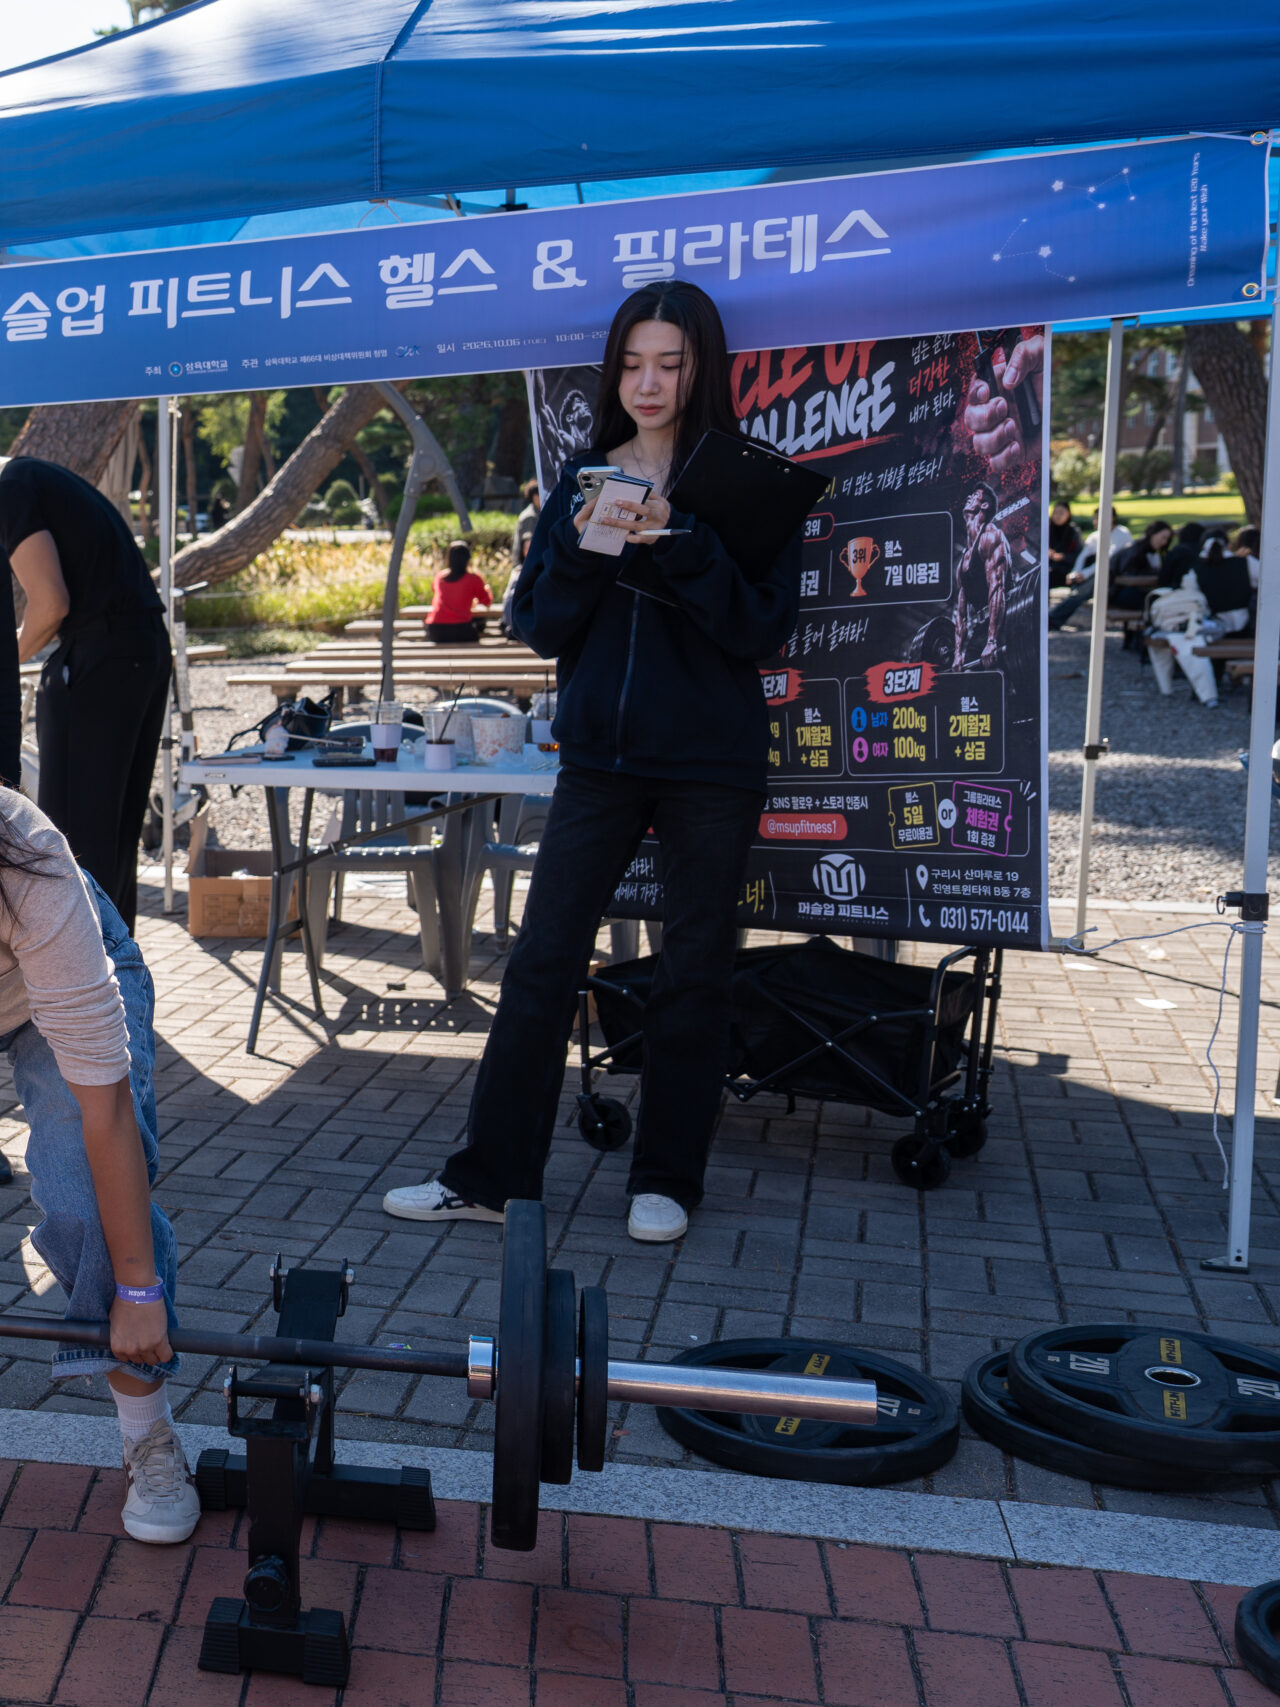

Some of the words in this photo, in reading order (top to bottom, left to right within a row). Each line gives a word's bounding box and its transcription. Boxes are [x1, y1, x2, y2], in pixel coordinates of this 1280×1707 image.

[128, 262, 352, 330] 피트니스
[379, 248, 498, 310] 헬스
[531, 238, 588, 291] &
[613, 209, 891, 289] 필라테스
[145, 366, 162, 376] 주최
[185, 359, 228, 372] 삼육대학교
[242, 358, 258, 368] 주관
[264, 356, 298, 366] 삼육대학교
[437, 344, 455, 354] 일시
[462, 339, 520, 350] 2026.10.06
[909, 403, 929, 424] 내가
[932, 388, 956, 417] 된다.
[842, 479, 852, 496] 더
[854, 472, 873, 496] 많은
[876, 464, 906, 491] 기회를
[908, 456, 943, 485] 만든다!
[804, 518, 821, 537] 3위
[852, 548, 866, 564] 3위
[884, 540, 902, 558] 헬스
[884, 565, 902, 586] 7일
[906, 562, 940, 585] 이용권
[802, 623, 824, 655] 들어
[828, 617, 869, 652] 올려라!
[884, 668, 921, 694] 3단계
[961, 696, 979, 712] 헬스
[804, 708, 822, 723] 헬스
[872, 712, 888, 728] 남자
[893, 707, 926, 733] 200kg
[949, 714, 991, 737] 2개월권
[796, 725, 832, 747] 1개월권
[872, 742, 888, 757] 여자
[894, 736, 926, 762] 100kg
[905, 792, 919, 804] 헬스
[903, 804, 924, 825] 5일
[941, 808, 954, 820] or
[965, 807, 999, 830] 체험권
[767, 818, 837, 836] @msupfitness1
[898, 827, 933, 842] 무료이용권
[967, 830, 979, 844] 1회
[980, 832, 996, 848] 증정
[931, 869, 961, 880] 구리시
[964, 870, 1003, 881] 산마루로
[1005, 872, 1019, 882] 19
[932, 884, 991, 896] 진영트윈타워
[993, 886, 1010, 897] B동
[1013, 887, 1031, 898] 7층
[798, 902, 835, 916] 머슬업
[838, 905, 889, 920] 피트니스
[940, 906, 967, 931] 031)
[971, 908, 1028, 932] 571-0144
[1070, 1354, 1110, 1375] 20
[1236, 1378, 1280, 1399] 20
